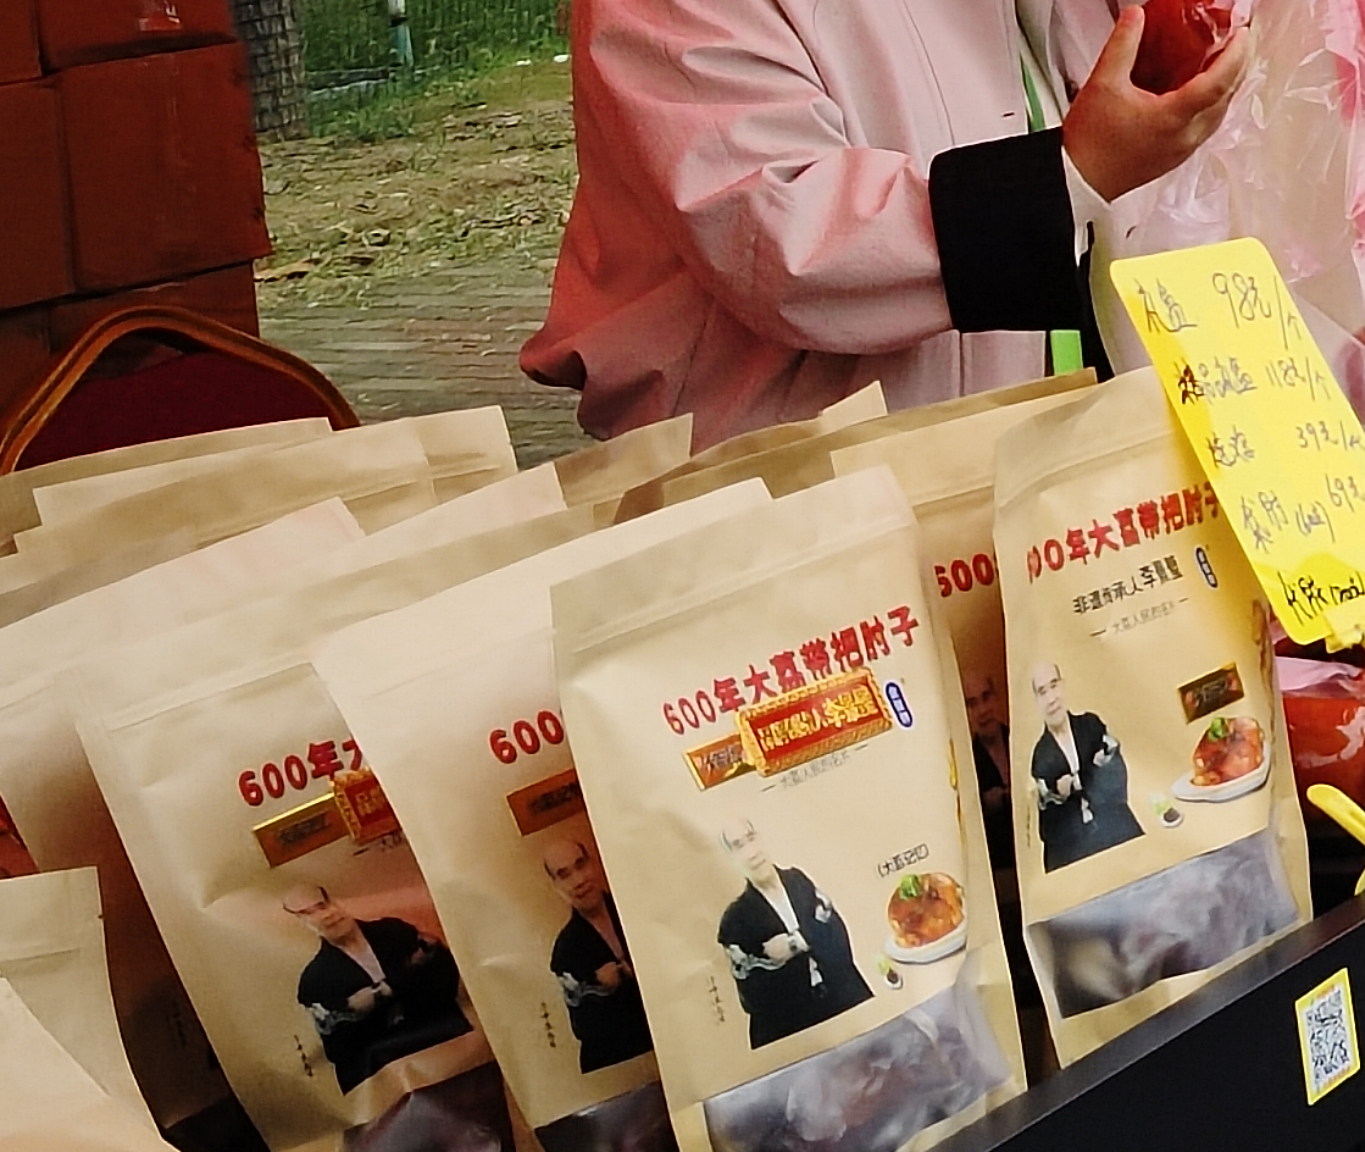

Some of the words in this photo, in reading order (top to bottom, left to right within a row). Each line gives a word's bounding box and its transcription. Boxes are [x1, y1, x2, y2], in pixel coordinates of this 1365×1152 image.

[663, 605, 920, 735] 600年大荔带把肘子
[488, 709, 565, 765] 600
